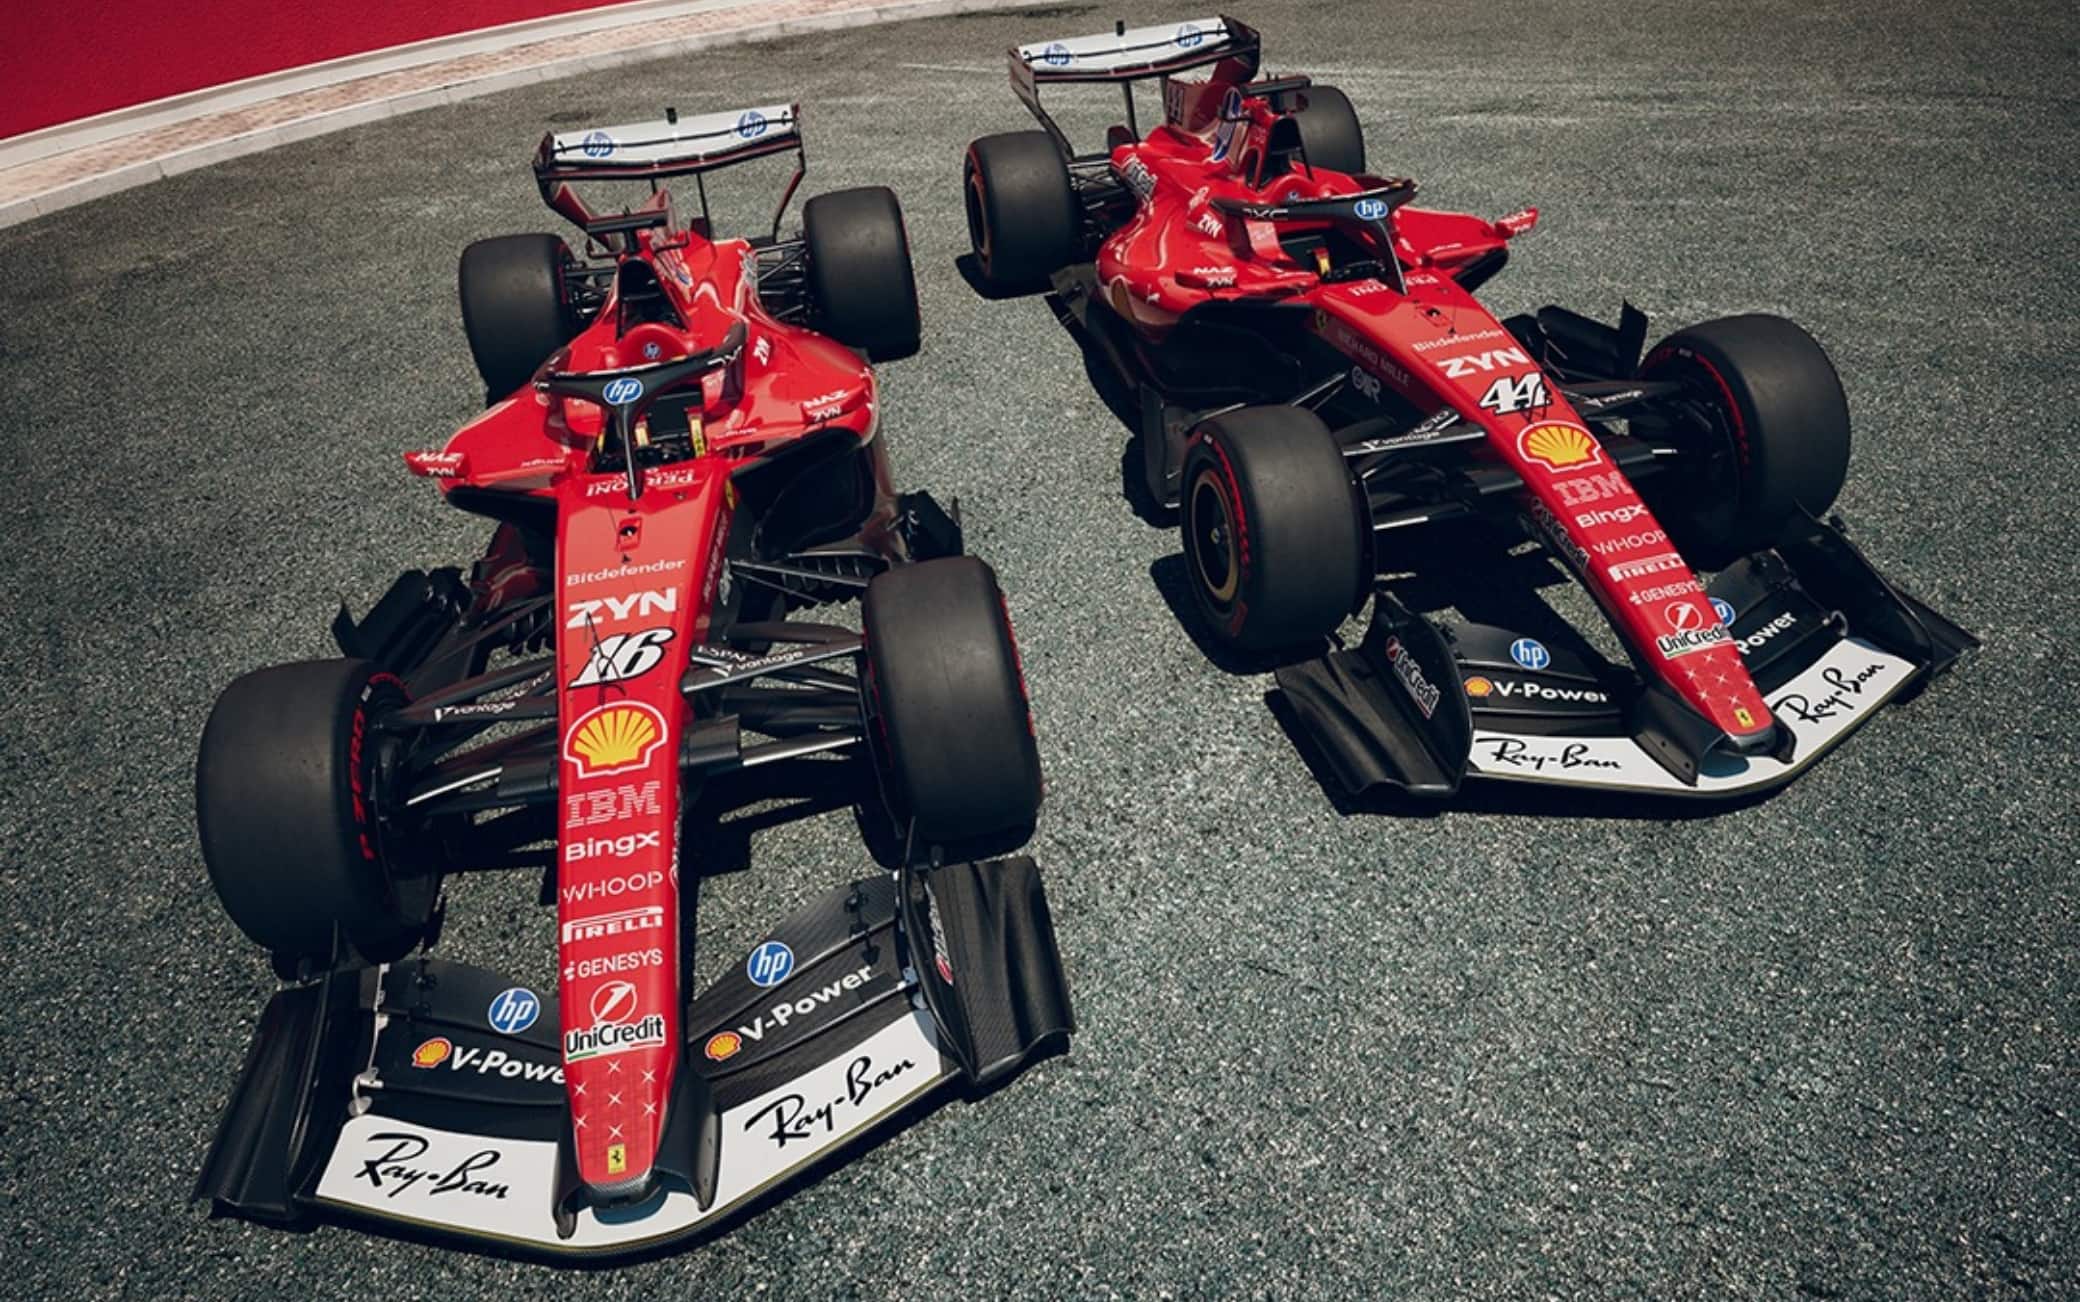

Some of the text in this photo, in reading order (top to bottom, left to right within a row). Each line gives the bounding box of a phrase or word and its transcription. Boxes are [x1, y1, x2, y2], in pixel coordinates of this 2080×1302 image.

[1360, 200, 1384, 219] hp
[1412, 329, 1504, 352] Bitdefender
[1436, 347, 1530, 378] ZYN
[607, 379, 640, 403] hp
[1478, 371, 1552, 416] 44
[1552, 471, 1634, 508] IBM
[1592, 530, 1667, 555] WHOOP
[566, 559, 686, 586] Bitdefender
[1608, 553, 1686, 582] PIRELLI
[566, 587, 677, 629] ZYN
[1736, 612, 1798, 654] Power
[567, 627, 676, 690] 16
[712, 651, 803, 677] Vantage
[1519, 639, 1542, 670] hp
[1494, 681, 1608, 702] V-Power
[1773, 664, 1885, 723] Ray-Ban
[1475, 738, 1621, 770] Ray-Ban
[566, 781, 661, 829] IBM
[563, 871, 664, 904] WHOOP
[562, 905, 664, 945] PIRELLI
[577, 948, 664, 979] GENESYS
[757, 942, 788, 985] hp
[495, 989, 534, 1033] hp
[739, 965, 874, 1042] V-Power
[566, 1016, 663, 1054] UniCredit
[451, 1046, 566, 1084] V-Powe
[744, 1055, 916, 1148] Ray-Ban
[354, 1132, 510, 1199] Ray-Ban
